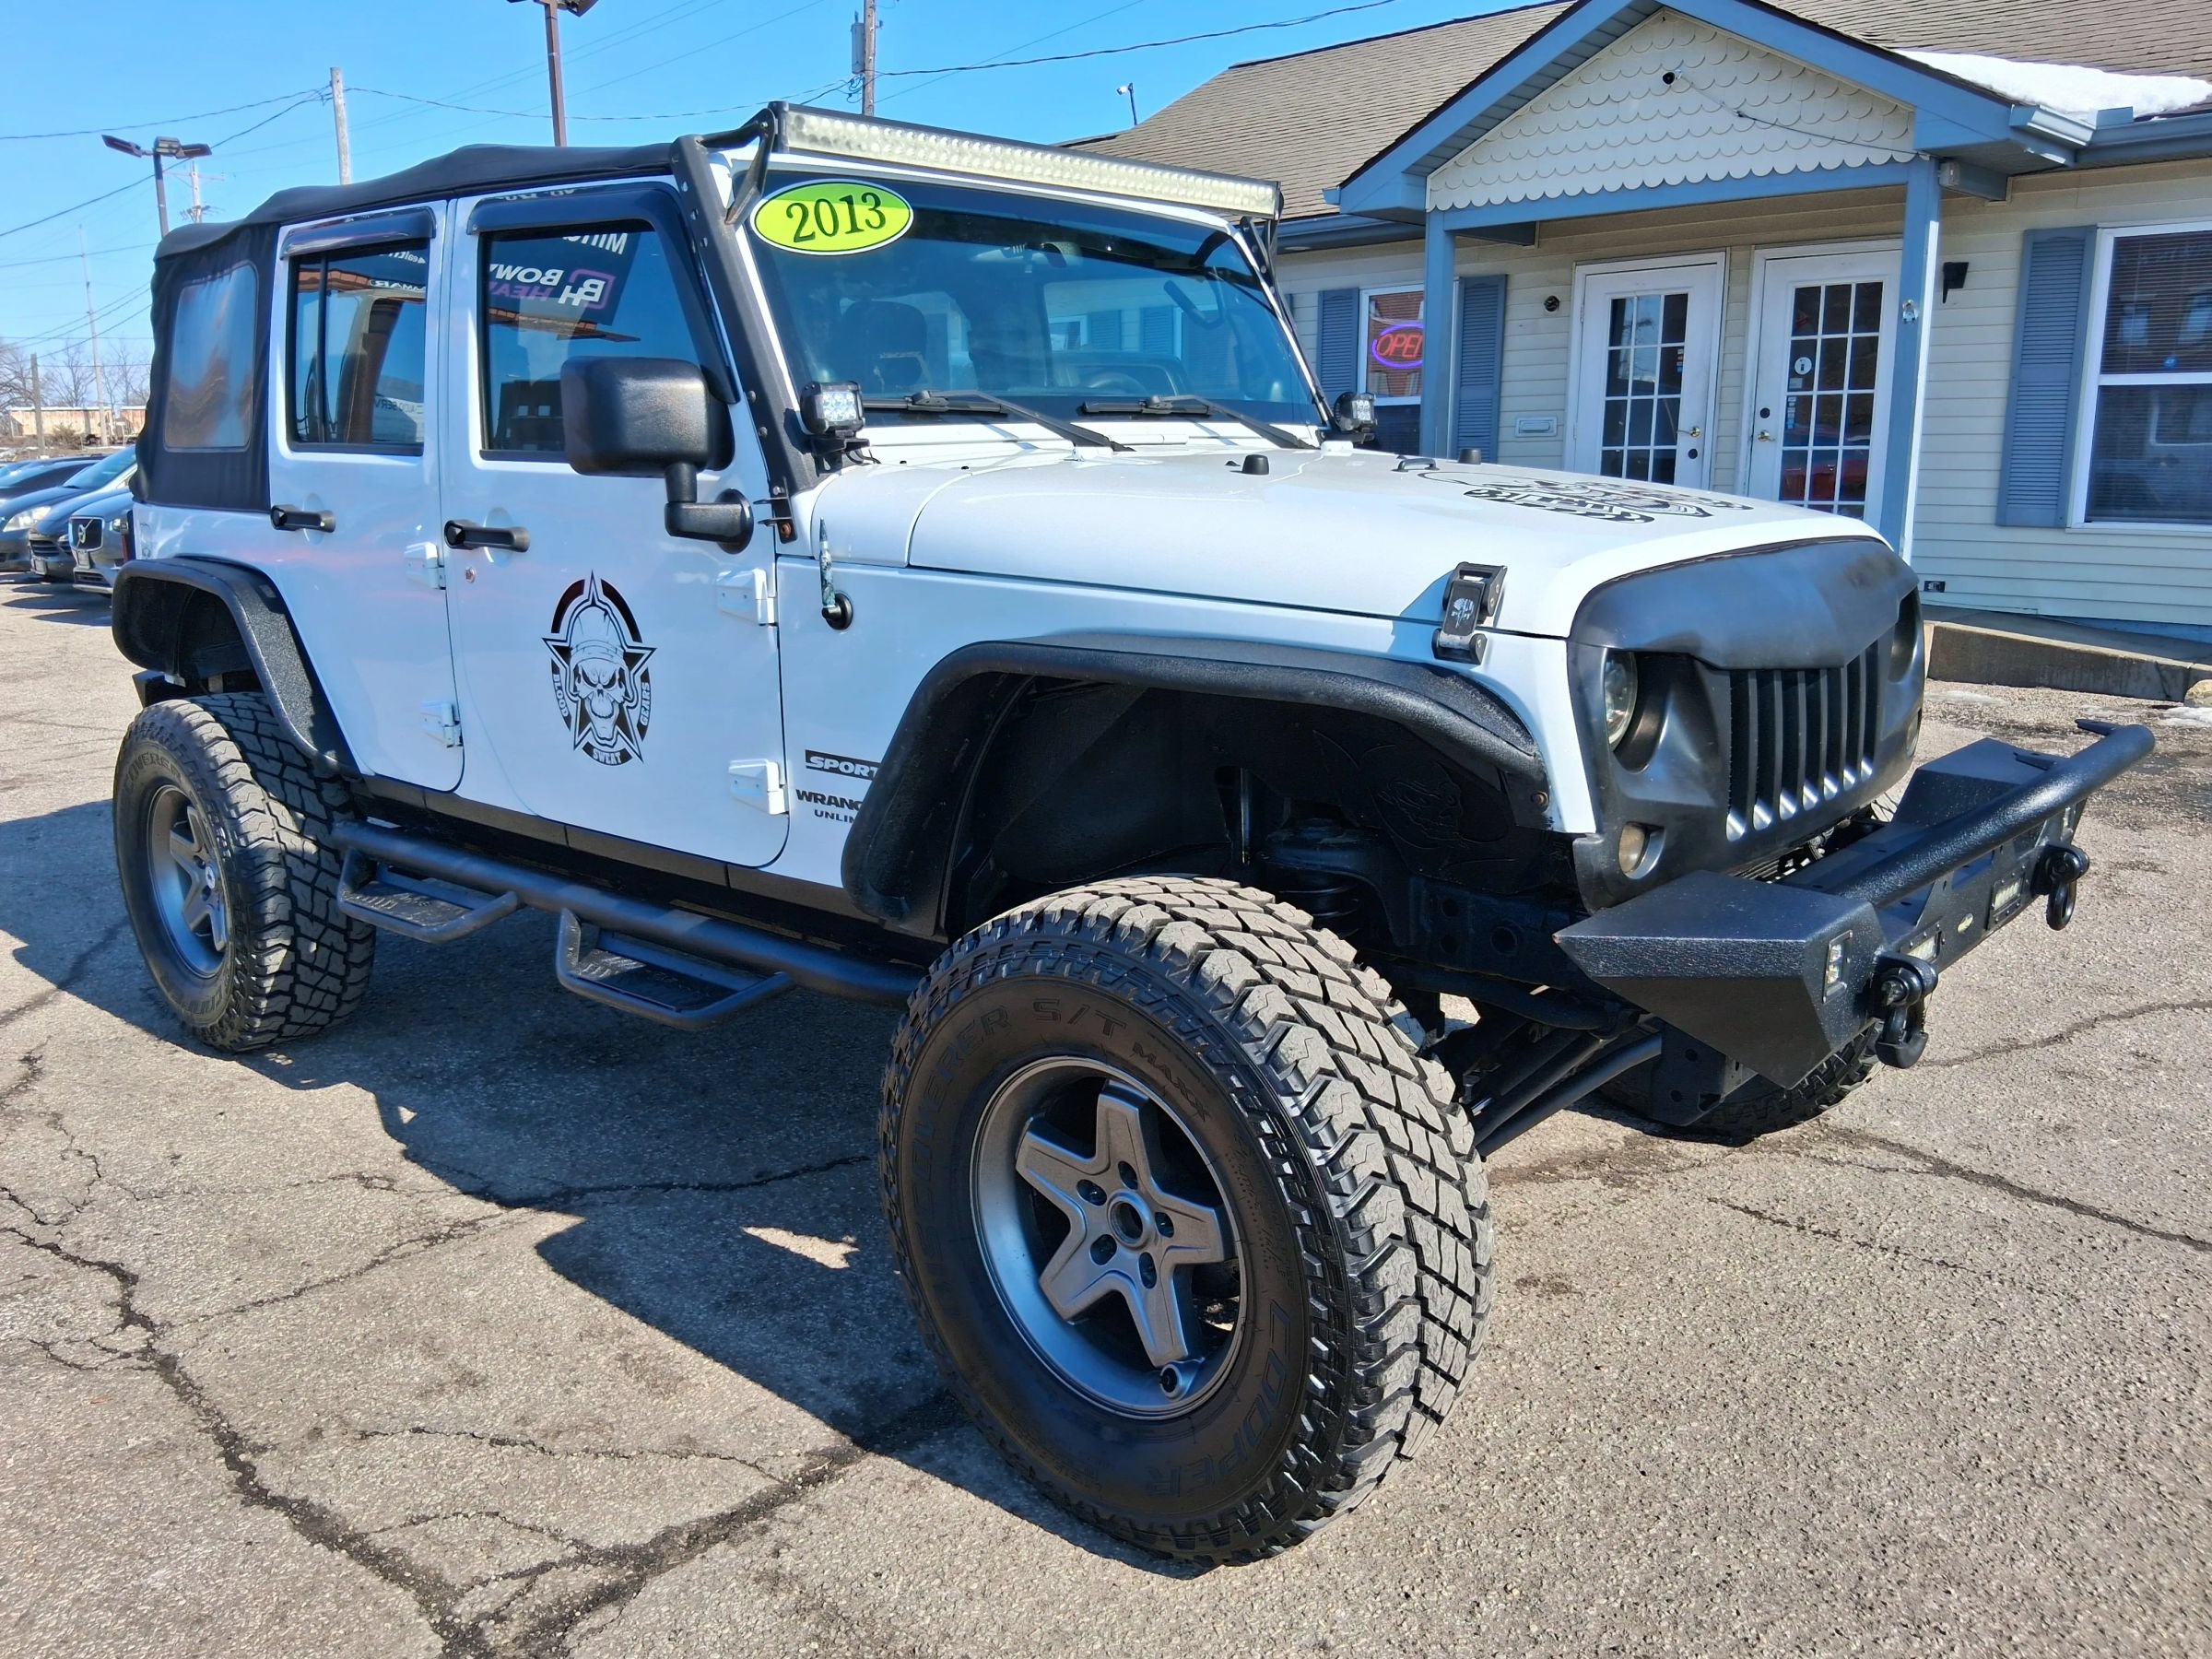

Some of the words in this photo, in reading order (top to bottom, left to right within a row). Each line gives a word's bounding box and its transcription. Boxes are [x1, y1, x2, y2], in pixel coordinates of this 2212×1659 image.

[785, 192, 887, 243] 2013
[552, 674, 570, 717] BLOOD
[593, 747, 622, 765] SWEAT
[912, 1004, 1012, 1298] ISCOVERER
[1031, 997, 1127, 1038] S/T
[1145, 1298, 1290, 1499] COOPER
